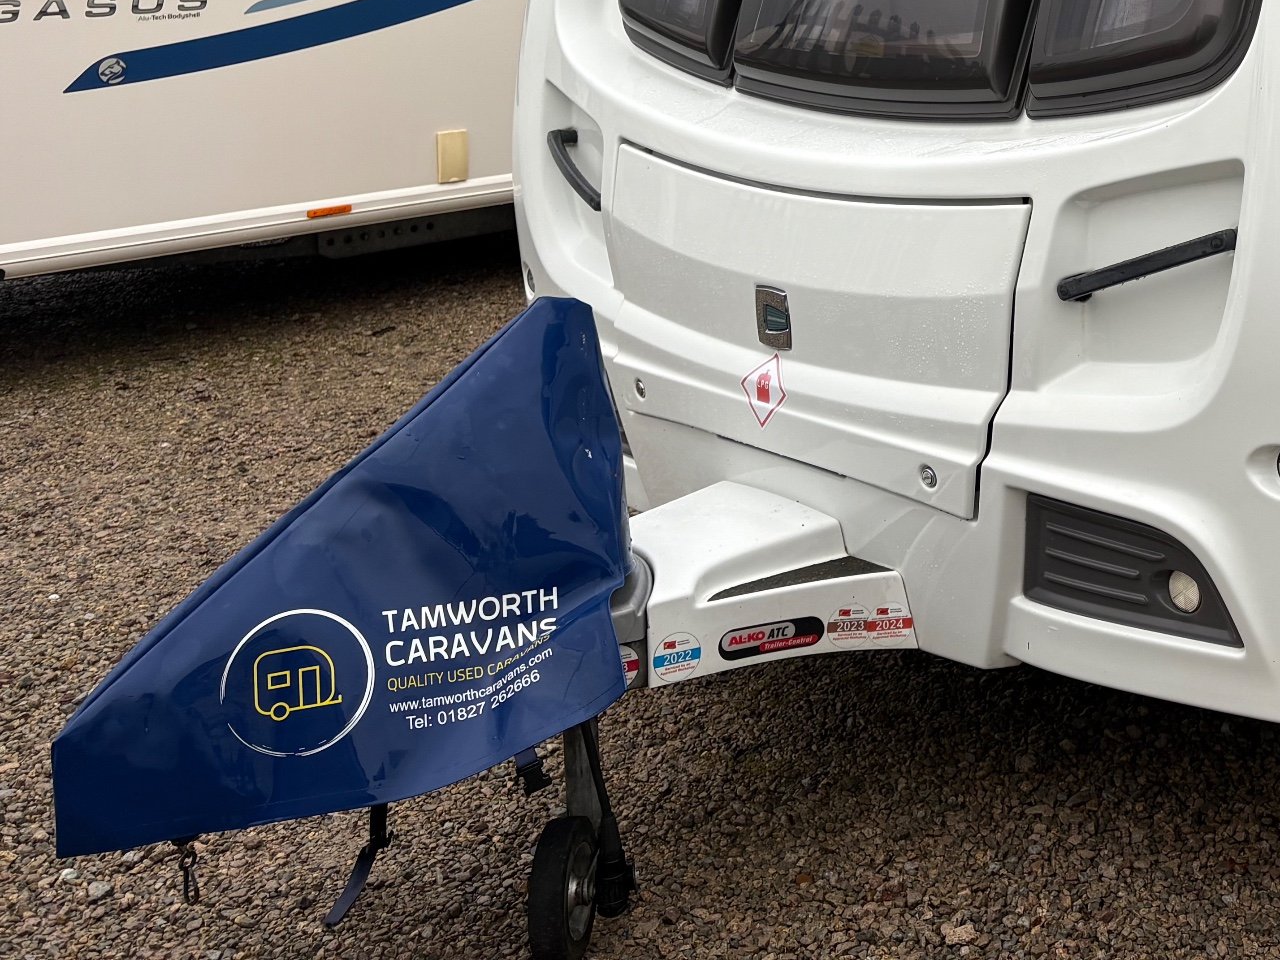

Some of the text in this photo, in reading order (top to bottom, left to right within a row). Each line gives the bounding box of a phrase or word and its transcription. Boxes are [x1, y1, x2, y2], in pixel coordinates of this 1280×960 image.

[757, 379, 769, 390] LPG
[381, 586, 559, 633] TAMWORTH
[767, 625, 789, 640] ATC
[837, 620, 865, 632] 2023
[876, 619, 904, 631] 2024
[385, 617, 559, 667] CARAVANS
[765, 636, 813, 650] Trailer-Control
[387, 634, 551, 693] QUALITY USED CARAVANS
[663, 649, 692, 666] 2022
[389, 646, 553, 713] www.tamworthcaravans.com
[406, 669, 541, 730] Tel: 01827 262666
